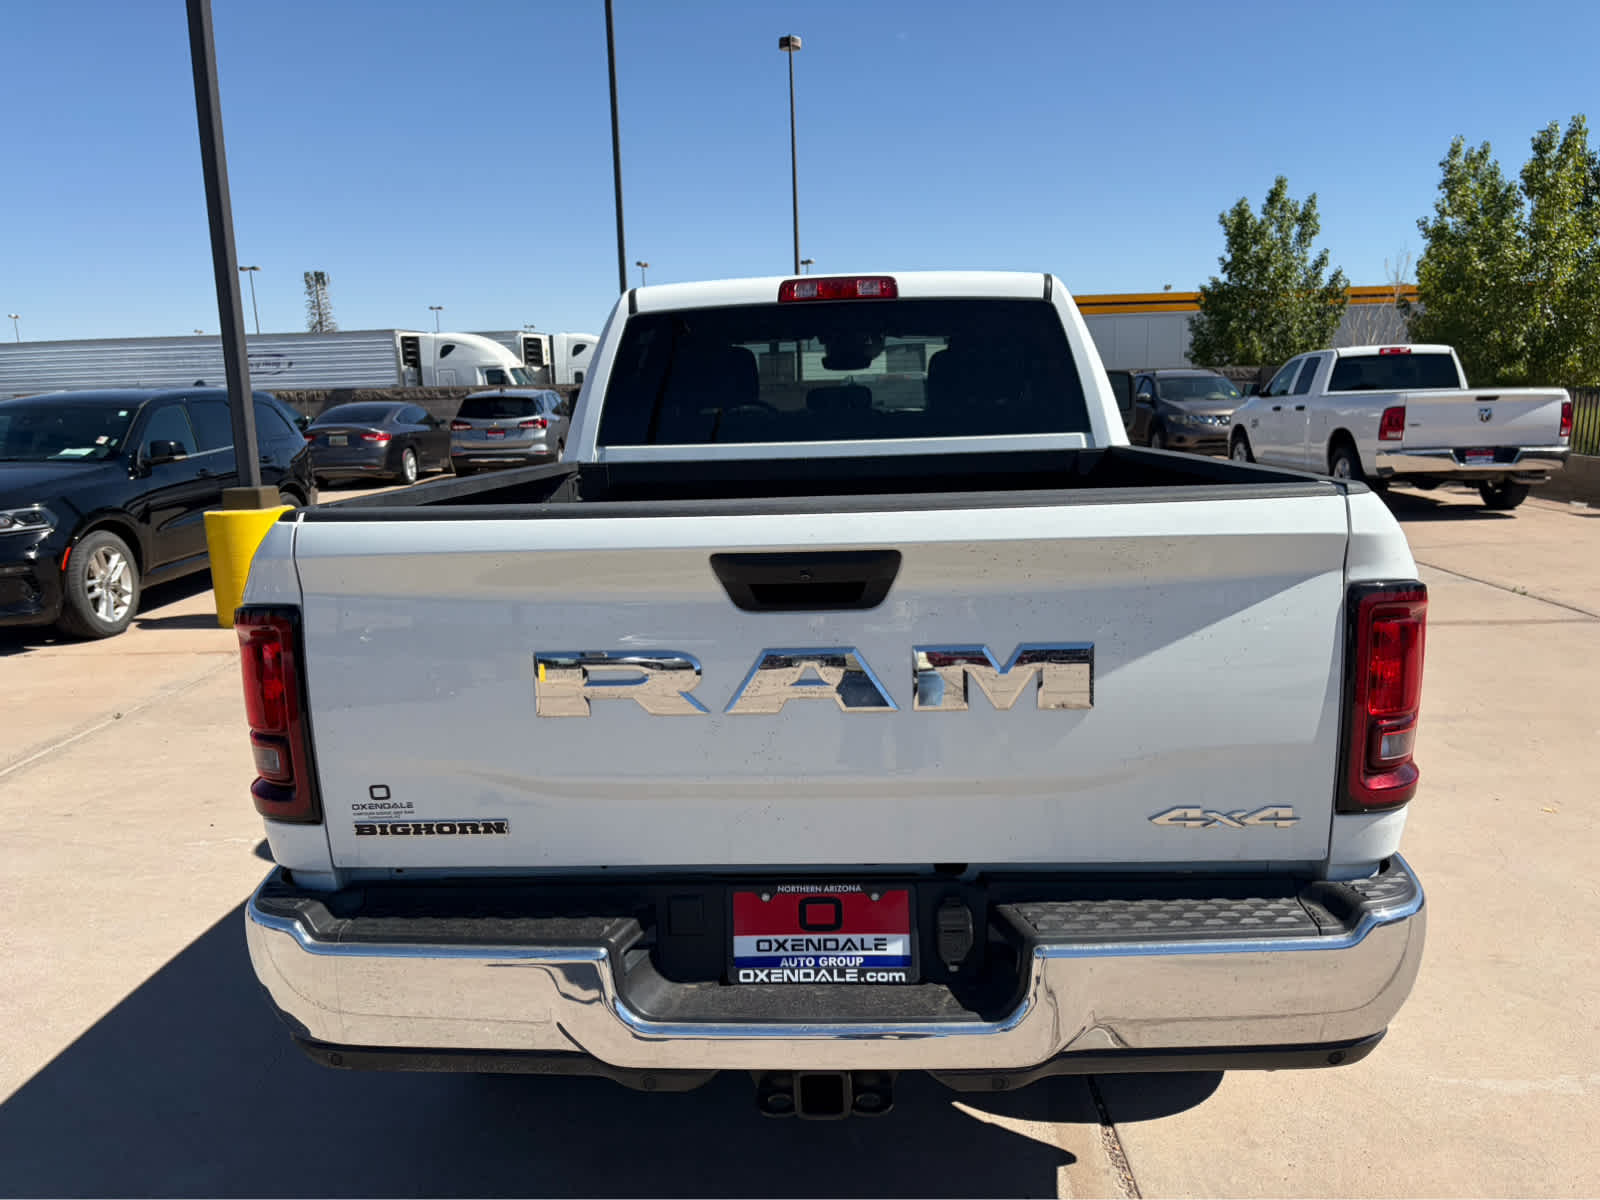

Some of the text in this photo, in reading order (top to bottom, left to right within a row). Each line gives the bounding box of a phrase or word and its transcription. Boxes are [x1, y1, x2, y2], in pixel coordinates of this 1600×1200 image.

[534, 642, 1094, 717] RAM
[352, 802, 414, 810] OXENDALE
[353, 820, 508, 836] BIGHORN
[777, 884, 862, 893] NORTHERN ARIZONA
[756, 937, 888, 952] OXENDALE
[780, 956, 864, 968] AUTO GROUP
[738, 968, 906, 983] OXENDALE.com
